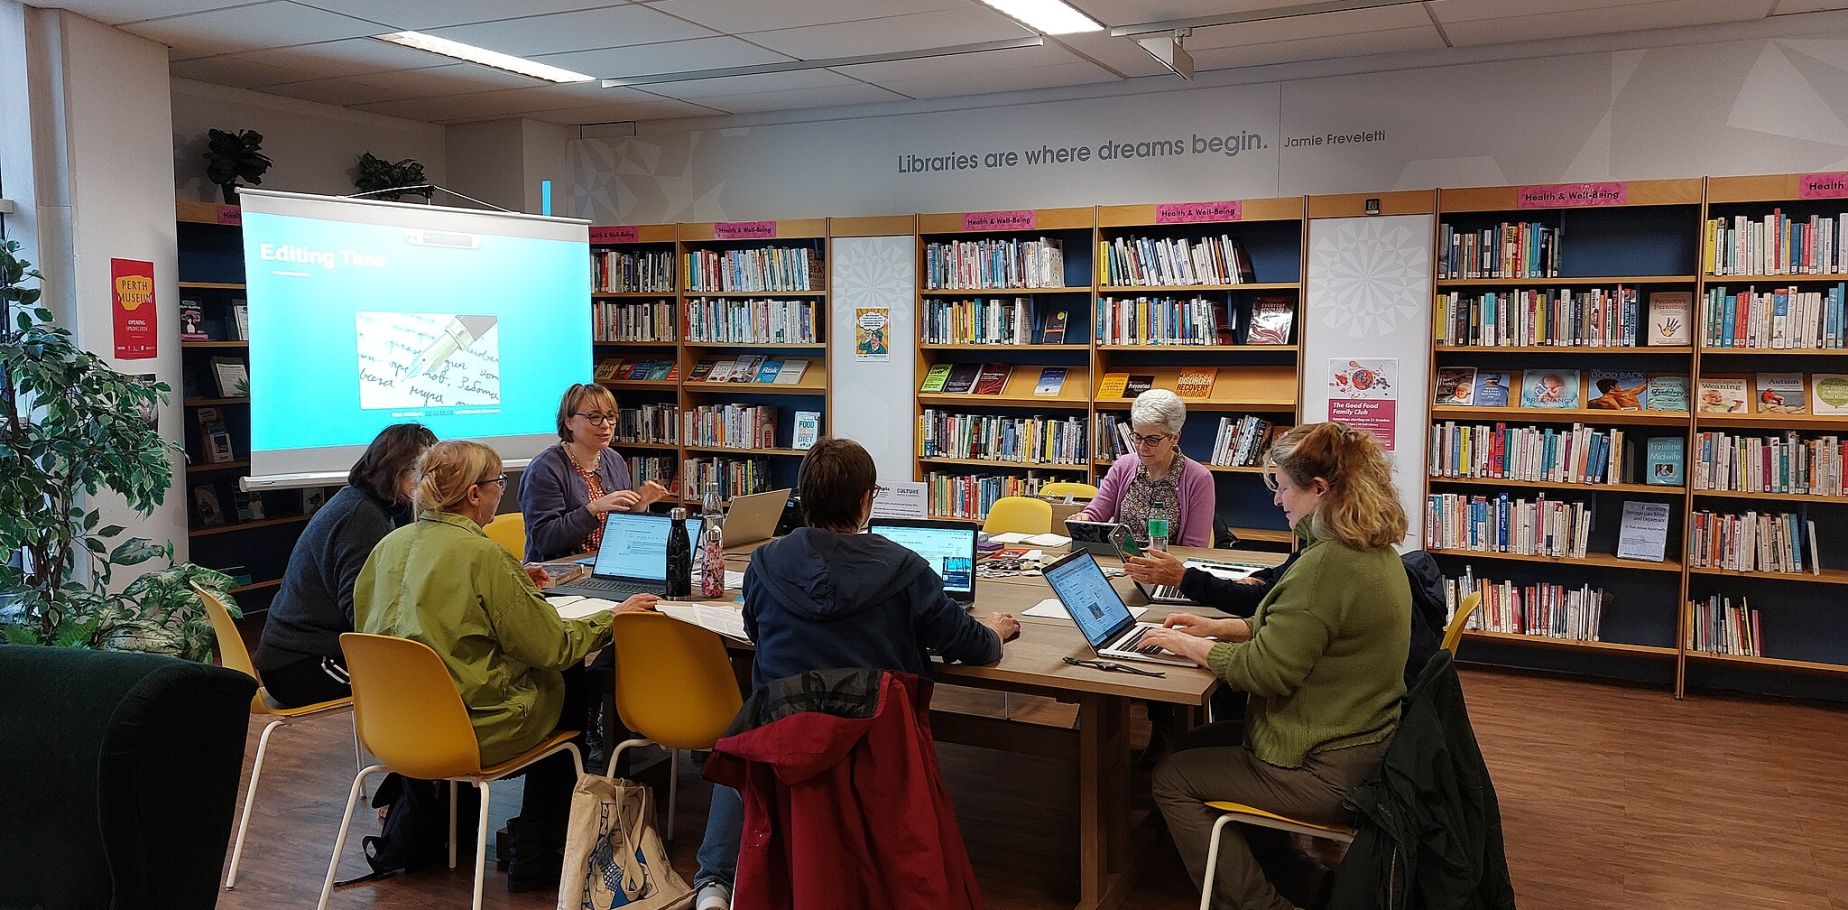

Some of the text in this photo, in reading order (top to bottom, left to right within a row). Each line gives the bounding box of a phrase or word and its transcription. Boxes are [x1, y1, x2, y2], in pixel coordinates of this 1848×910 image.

[1284, 130, 1386, 148] Jamie Freveletti
[898, 130, 1270, 174] Libraries are where dreams begin.
[1809, 181, 1844, 190] Health
[1526, 190, 1619, 202] Health & Well-Being
[224, 211, 239, 219] Heal
[1195, 208, 1235, 216] Well-Being
[996, 216, 1031, 225] Well-Being
[743, 226, 772, 234] Well-Being
[260, 243, 386, 268] Editing Time
[121, 280, 148, 291] PERTH
[118, 292, 152, 304] MUSEUM
[1178, 376, 1213, 385] DISORDER
